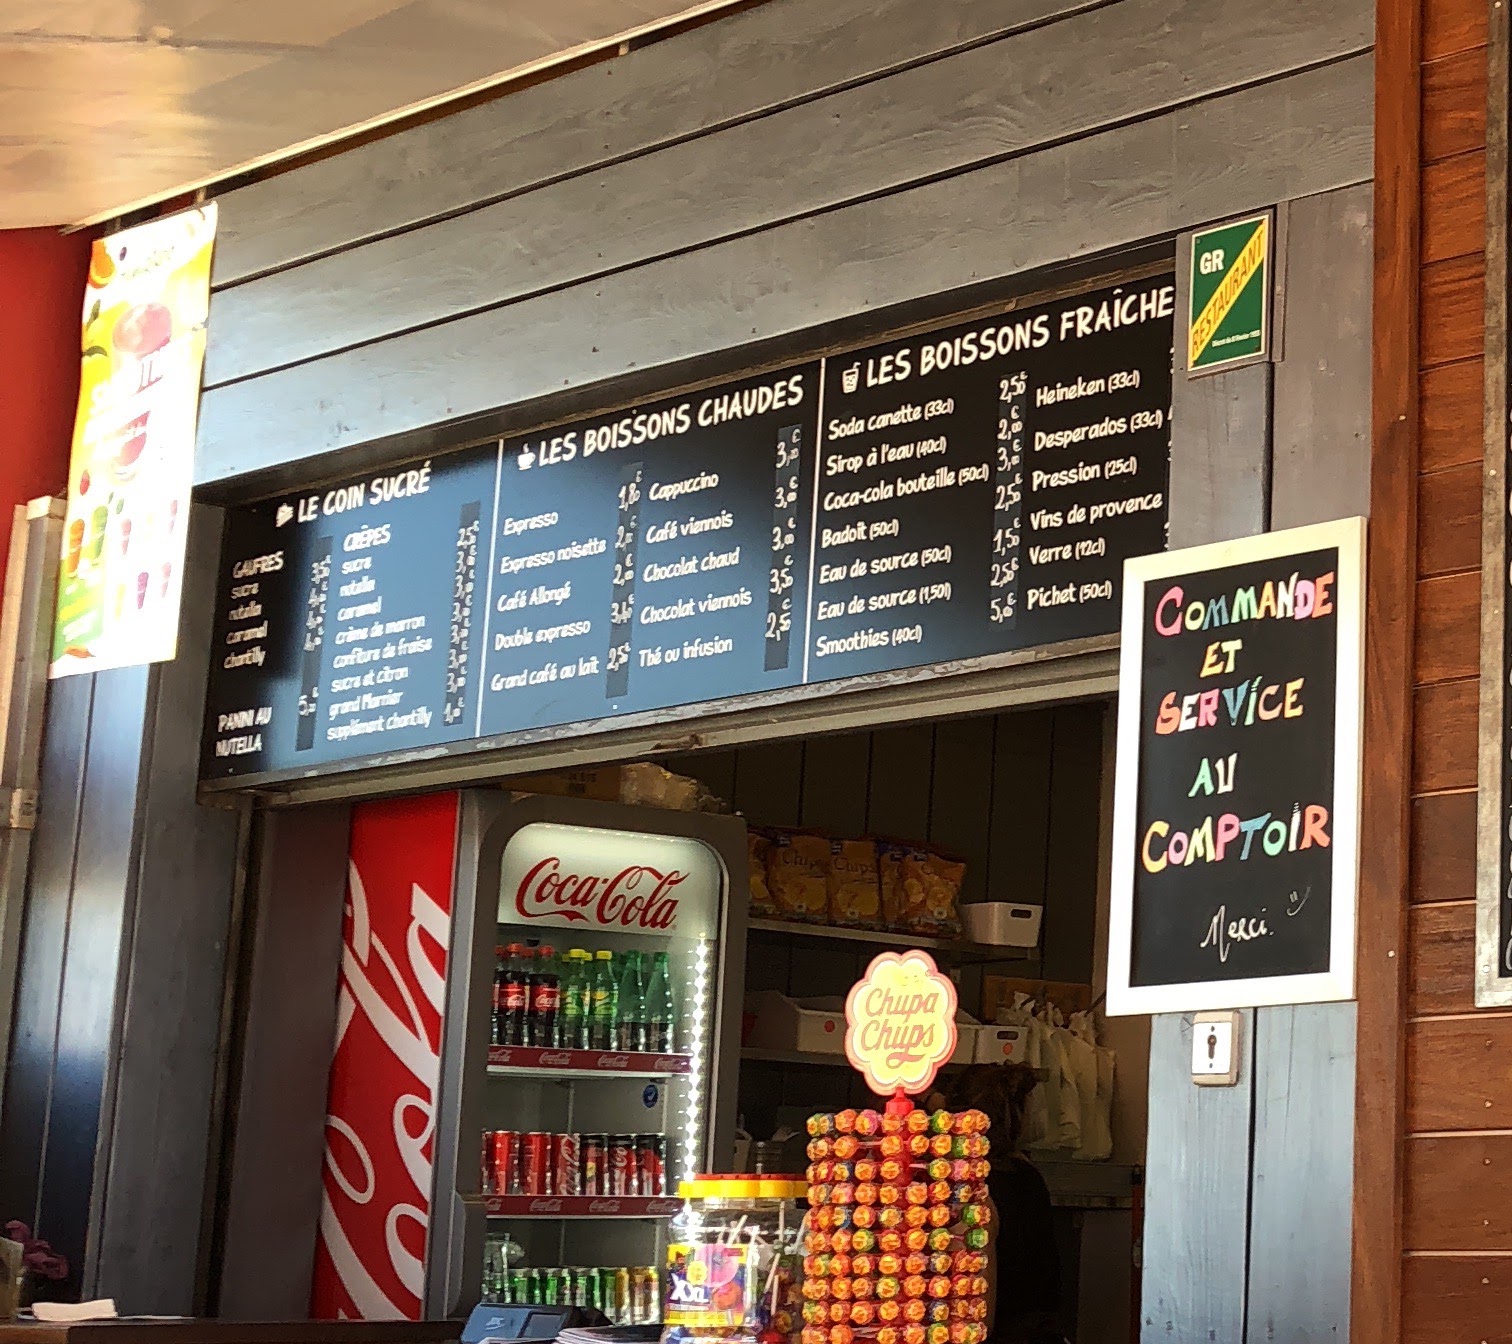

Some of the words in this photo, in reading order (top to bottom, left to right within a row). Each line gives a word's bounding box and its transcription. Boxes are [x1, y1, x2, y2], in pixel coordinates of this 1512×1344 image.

[1199, 248, 1225, 275] GR
[1191, 229, 1265, 358] RESTAURANT
[866, 348, 912, 388] LES
[919, 314, 1050, 377] BOISSONS
[1035, 376, 1106, 408] Heineken
[539, 432, 577, 467] LES
[583, 403, 691, 457] BOISSONS
[698, 375, 804, 426] CHAUDES
[828, 416, 865, 441] Soda
[867, 403, 922, 431] canette
[1034, 416, 1128, 452] Desperados
[826, 453, 863, 476] Sirop
[866, 447, 877, 467] à
[880, 442, 915, 464] l'eau
[1032, 461, 1101, 492] Pression
[297, 495, 320, 524] LE
[323, 482, 365, 516] COIN
[369, 459, 433, 505] SUCRÉ
[649, 472, 720, 501] Cappuccino
[823, 480, 894, 512] Coca-cola
[896, 465, 956, 497] bouteille
[503, 511, 559, 536] Expresso
[646, 521, 678, 544] Café
[680, 510, 734, 536] viennois
[1030, 509, 1063, 531] Vins
[1067, 504, 1086, 524] de
[1089, 492, 1163, 524] provence
[821, 520, 867, 549] Badoit
[500, 550, 555, 574] Expresso
[557, 538, 607, 561] noisette
[643, 556, 699, 583] Chocolat
[700, 546, 741, 571] chaud
[818, 564, 847, 585] Eau
[850, 558, 868, 578] de
[870, 551, 919, 575] source
[1029, 542, 1072, 565] Verre
[497, 590, 527, 612] Café
[640, 598, 696, 625] Chocolat
[698, 587, 753, 613] viennois
[817, 600, 845, 621] Eau
[847, 594, 866, 615] de
[868, 588, 917, 612] source
[1027, 582, 1077, 610] Pichet
[494, 627, 534, 651] Double
[535, 620, 592, 643] expresso
[639, 646, 662, 667] Thé
[664, 647, 680, 663] ou
[683, 636, 733, 659] infusion
[816, 628, 890, 657] Smoothies
[1199, 638, 1243, 678] ET
[491, 669, 527, 691] Grand
[529, 663, 558, 684] café
[560, 664, 576, 680] au
[1154, 675, 1305, 735] SERVICE
[1188, 752, 1238, 798] AU
[1141, 802, 1332, 874] COMPTOIR
[515, 856, 691, 929] Coca-Cola
[866, 987, 939, 1024] Chupa
[861, 1019, 936, 1058] Chups
